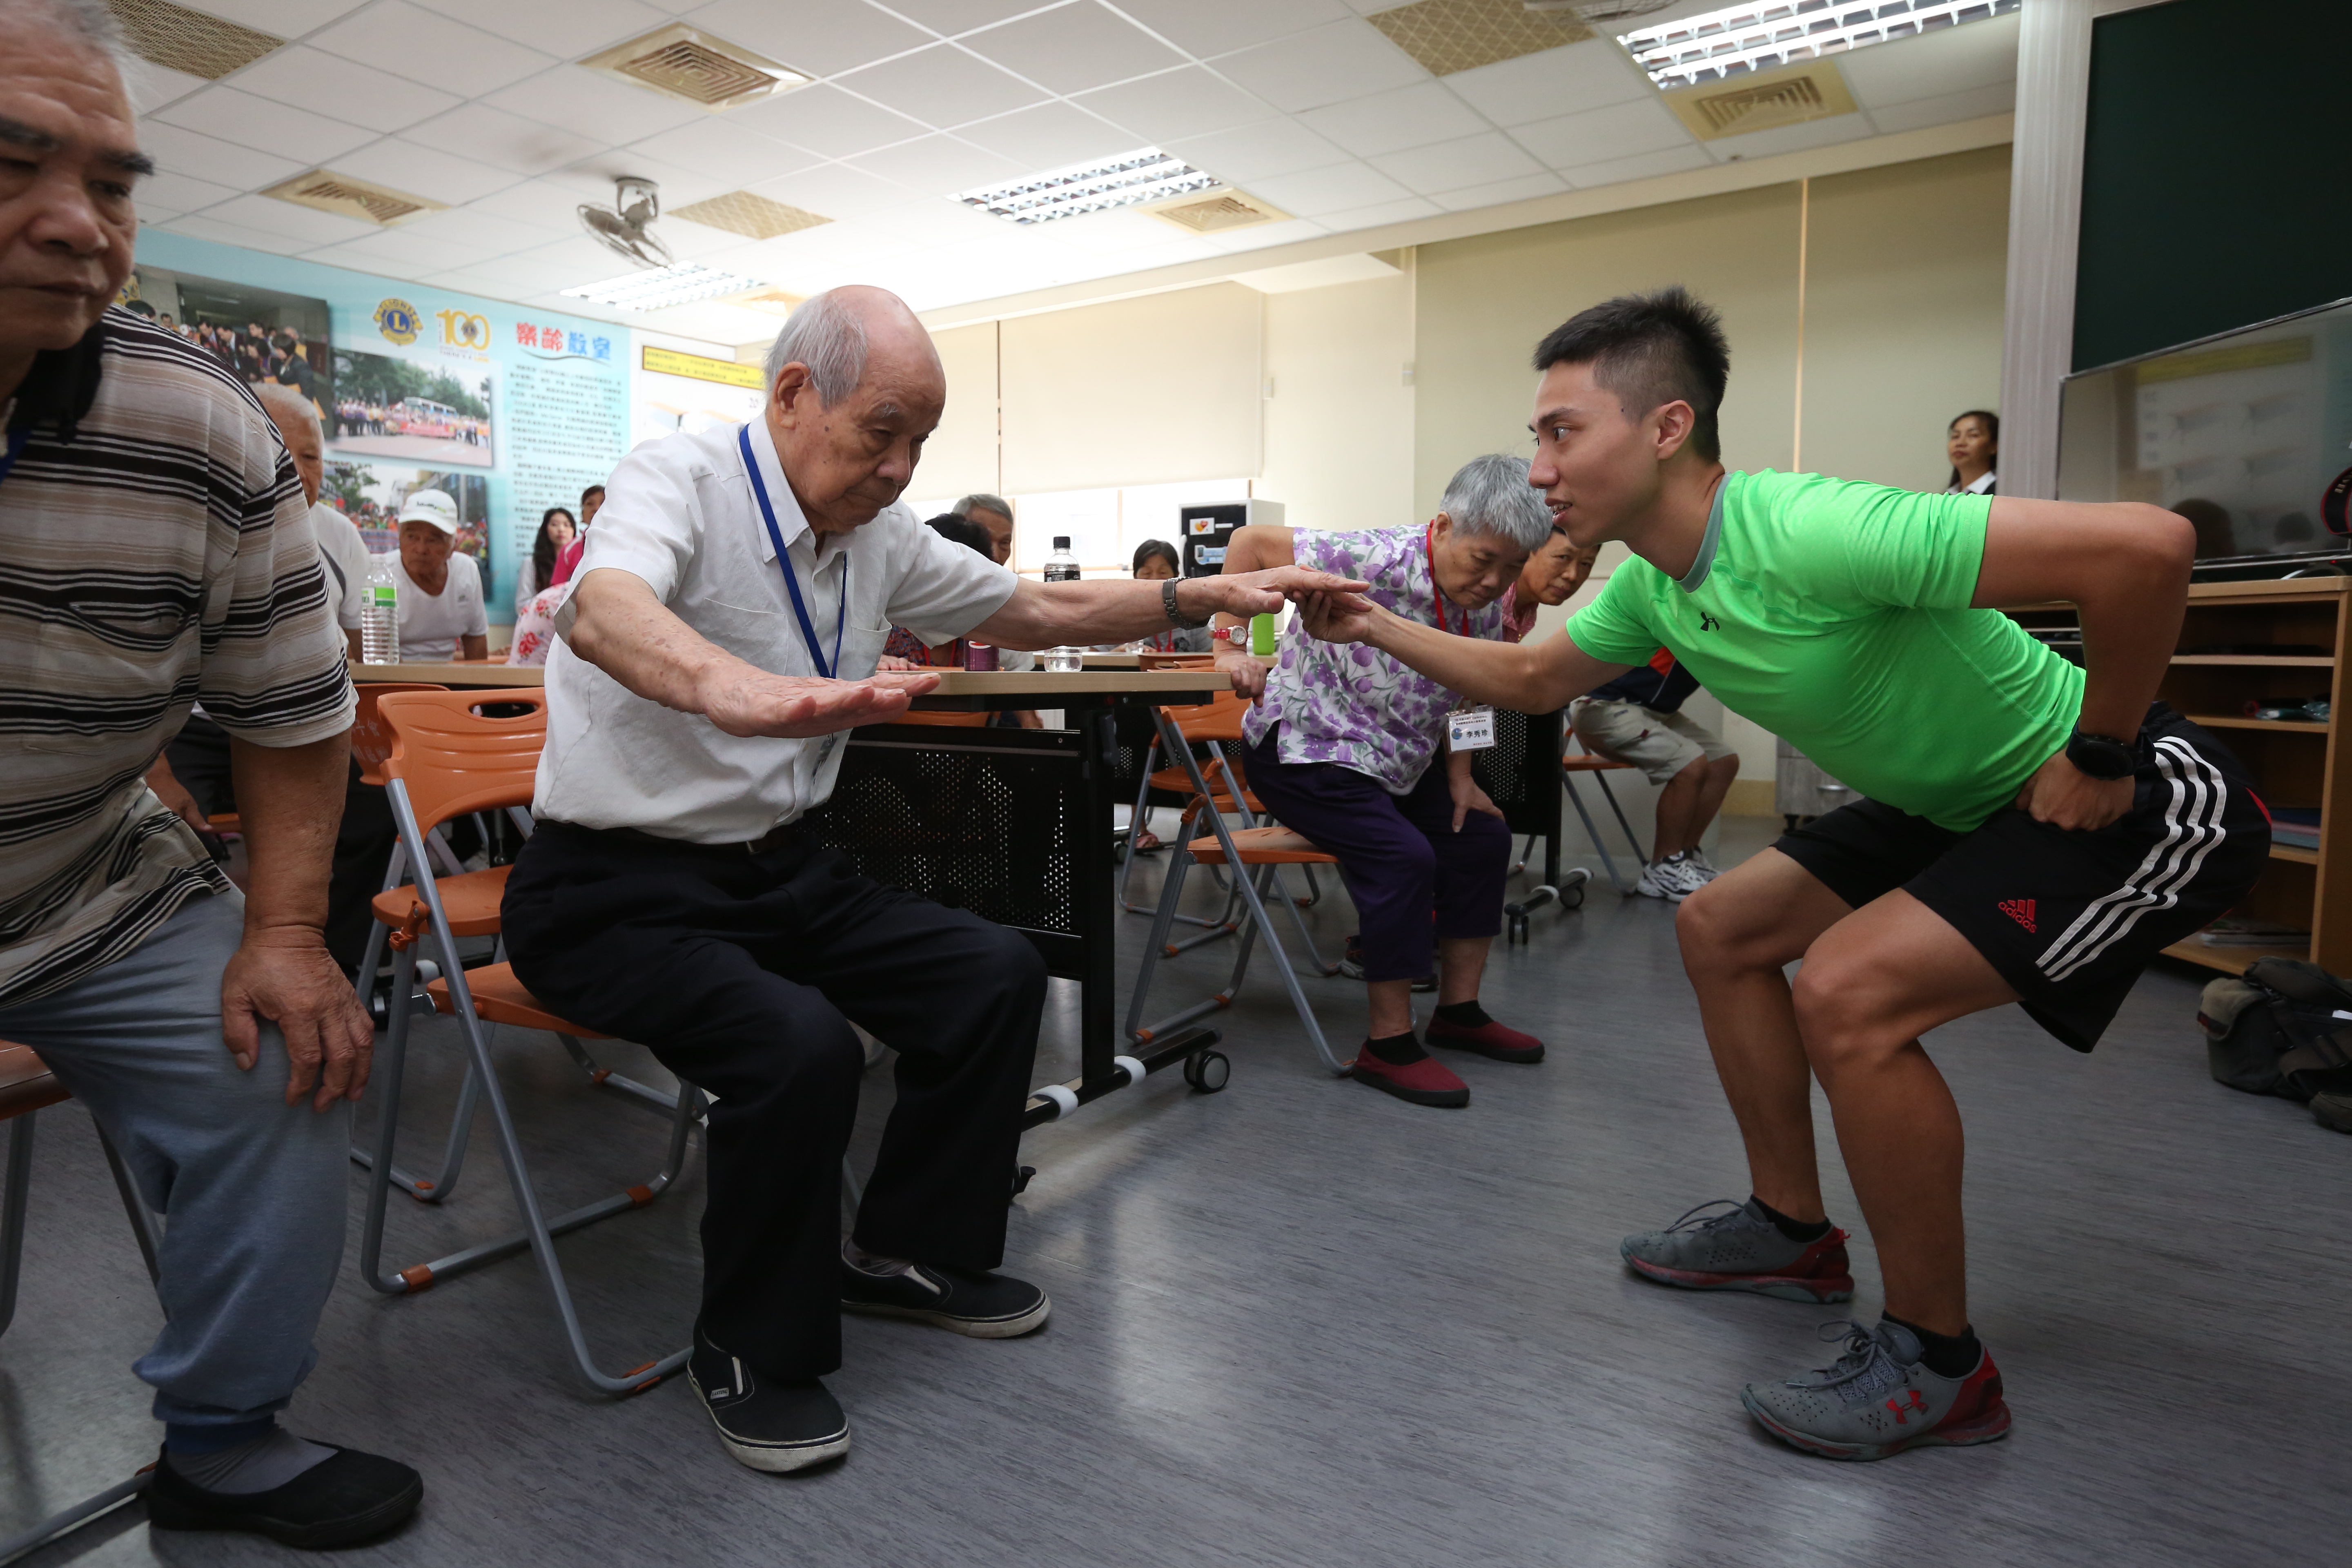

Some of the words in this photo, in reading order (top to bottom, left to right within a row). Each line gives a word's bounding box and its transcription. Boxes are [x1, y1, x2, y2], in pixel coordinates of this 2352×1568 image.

[393, 312, 406, 330] L
[436, 309, 490, 351] 100
[1998, 902, 2037, 933] adidas
